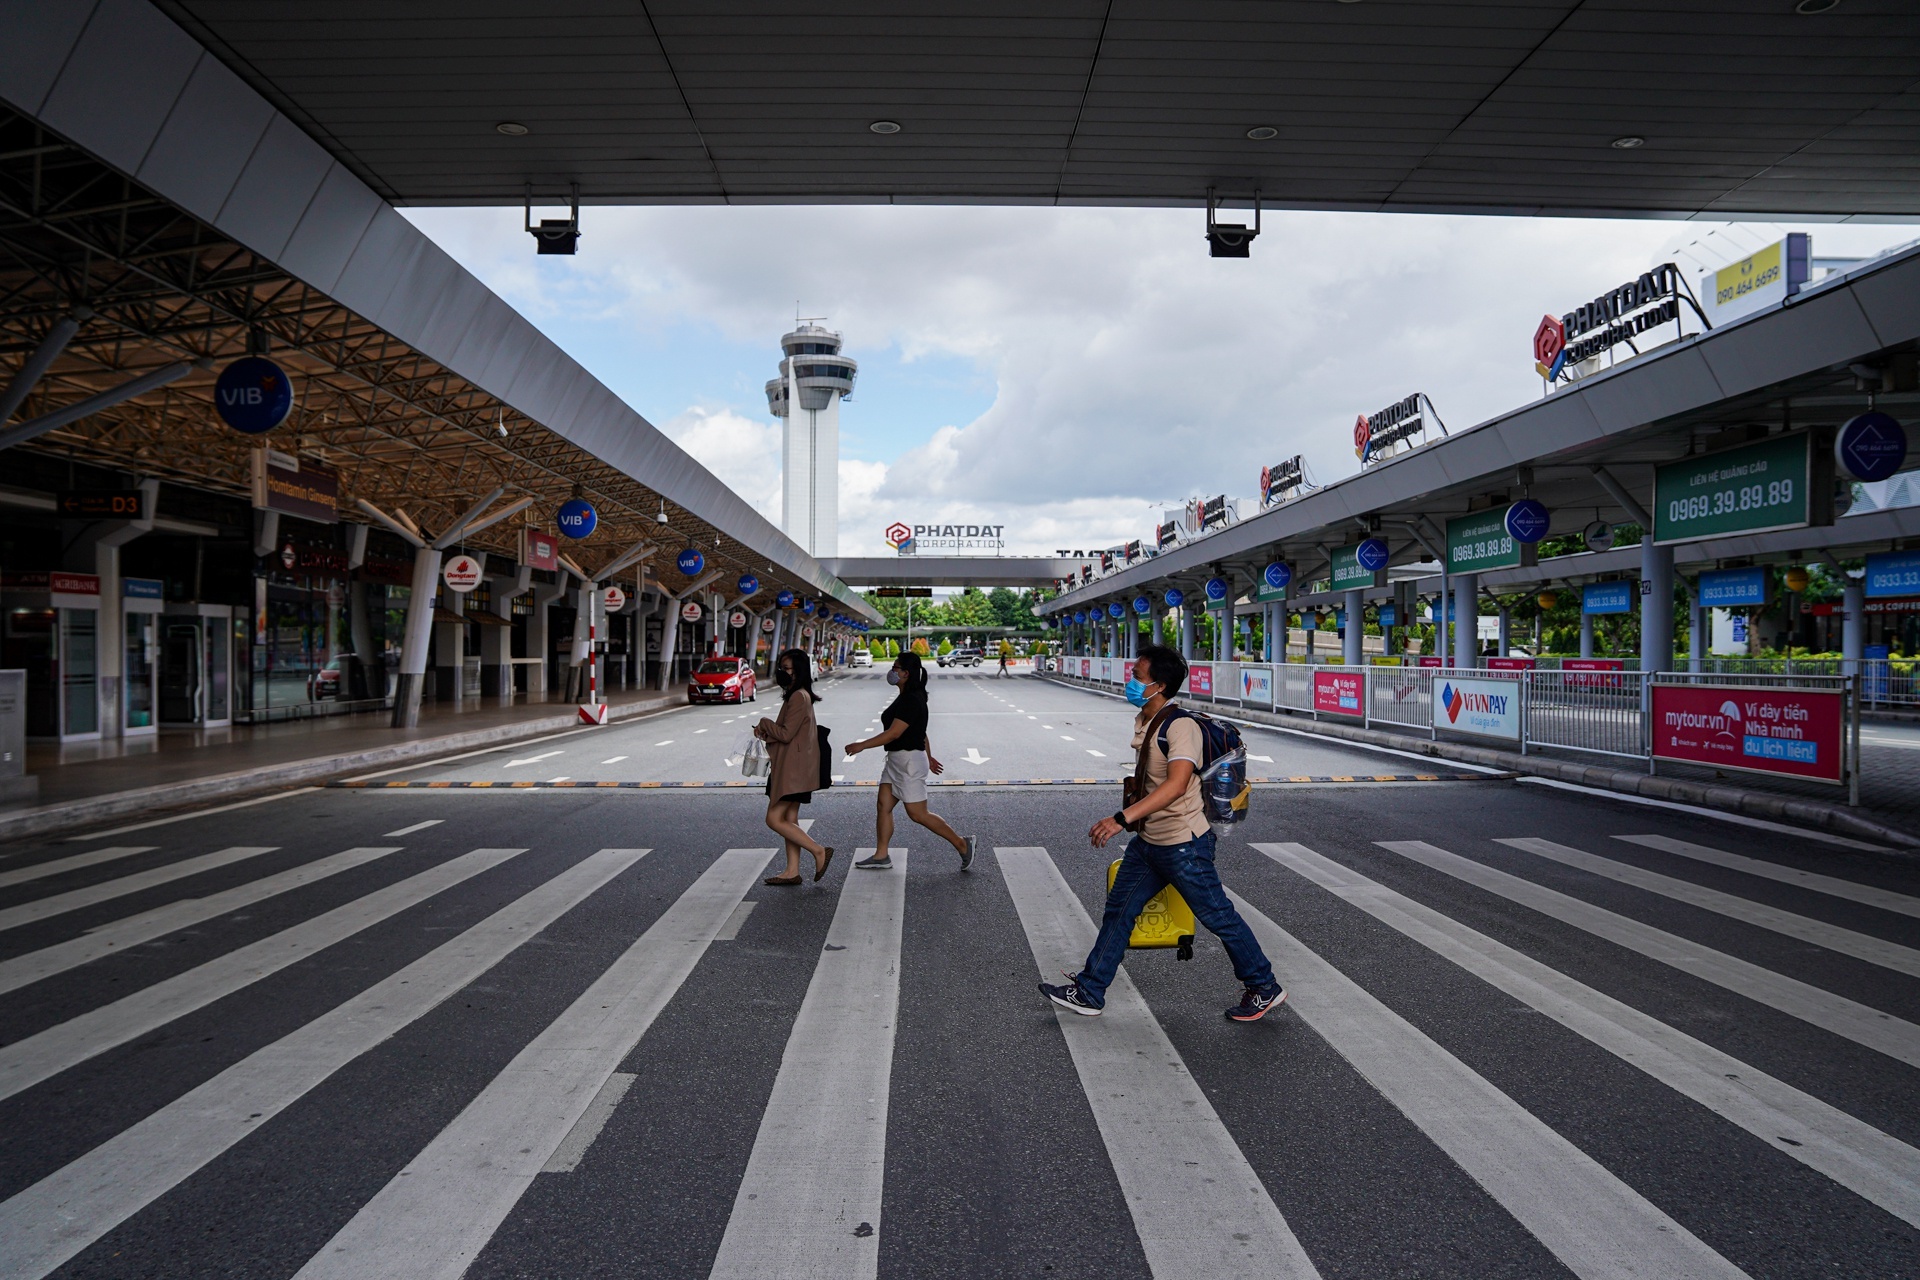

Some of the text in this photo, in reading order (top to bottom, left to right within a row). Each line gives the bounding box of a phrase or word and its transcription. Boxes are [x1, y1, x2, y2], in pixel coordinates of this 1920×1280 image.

[1717, 266, 1778, 304] 090 464 6699
[1563, 263, 1674, 340] PHATDAT
[1565, 300, 1677, 363] CORPORATION
[221, 387, 262, 406] VIB
[1368, 392, 1420, 434] PHATDAT
[1690, 472, 1707, 486] LIÊN
[112, 496, 138, 513] D3
[1669, 479, 1793, 522] 0969.39.89.89
[561, 515, 583, 526] VIB
[914, 525, 1004, 537] PHATDAT
[914, 540, 1004, 548] CORPORATION
[1453, 537, 1513, 562] 0969.39.89.89
[679, 559, 694, 567] VIB
[53, 577, 97, 592] AGRIBANK
[1474, 693, 1508, 715] VNPAY
[1745, 702, 1809, 722] Ví dày tiền
[1665, 710, 1724, 731] mytour.vn
[1745, 721, 1803, 740] Nhà mình
[1744, 739, 1760, 753] du
[1787, 741, 1813, 760] liền!
